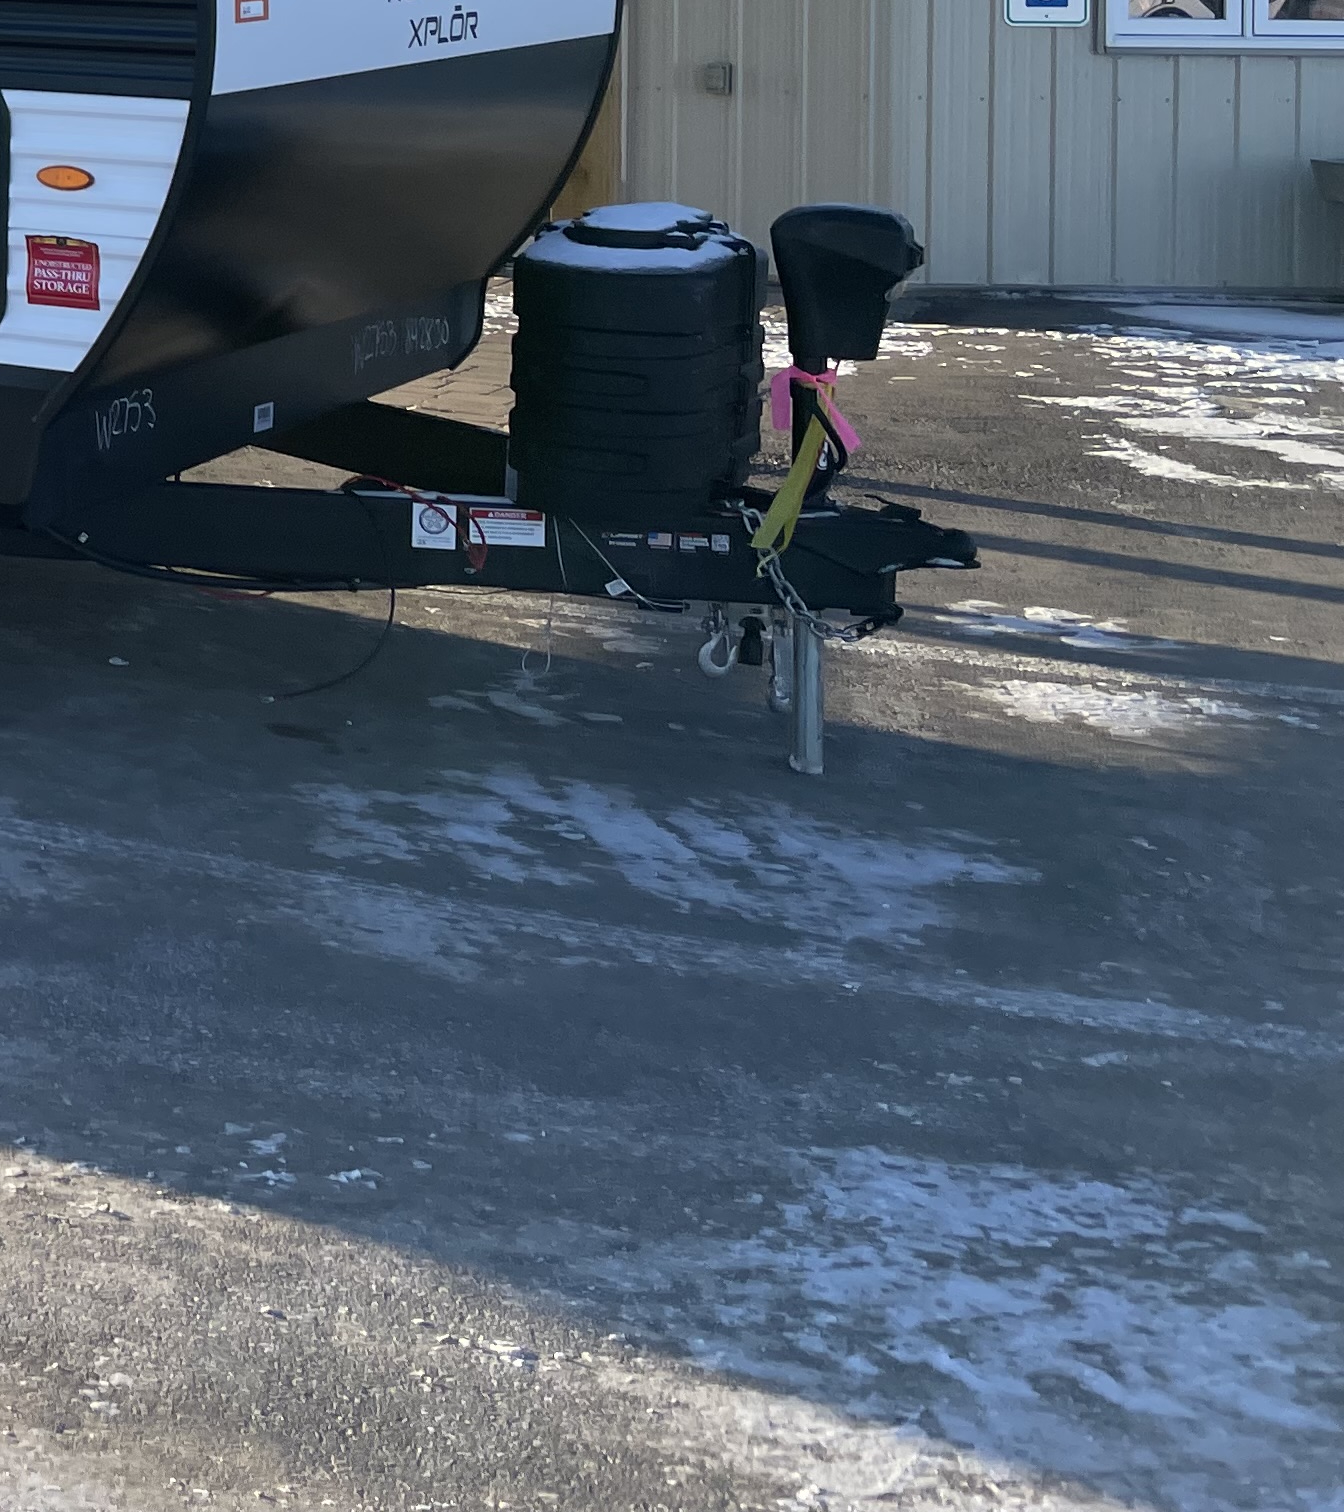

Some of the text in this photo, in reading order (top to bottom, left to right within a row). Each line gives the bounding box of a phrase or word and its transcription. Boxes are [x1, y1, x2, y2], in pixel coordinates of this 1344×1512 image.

[33, 267, 91, 282] PASS-THRU
[33, 279, 90, 295] STORAGE
[95, 388, 157, 450] W2753
